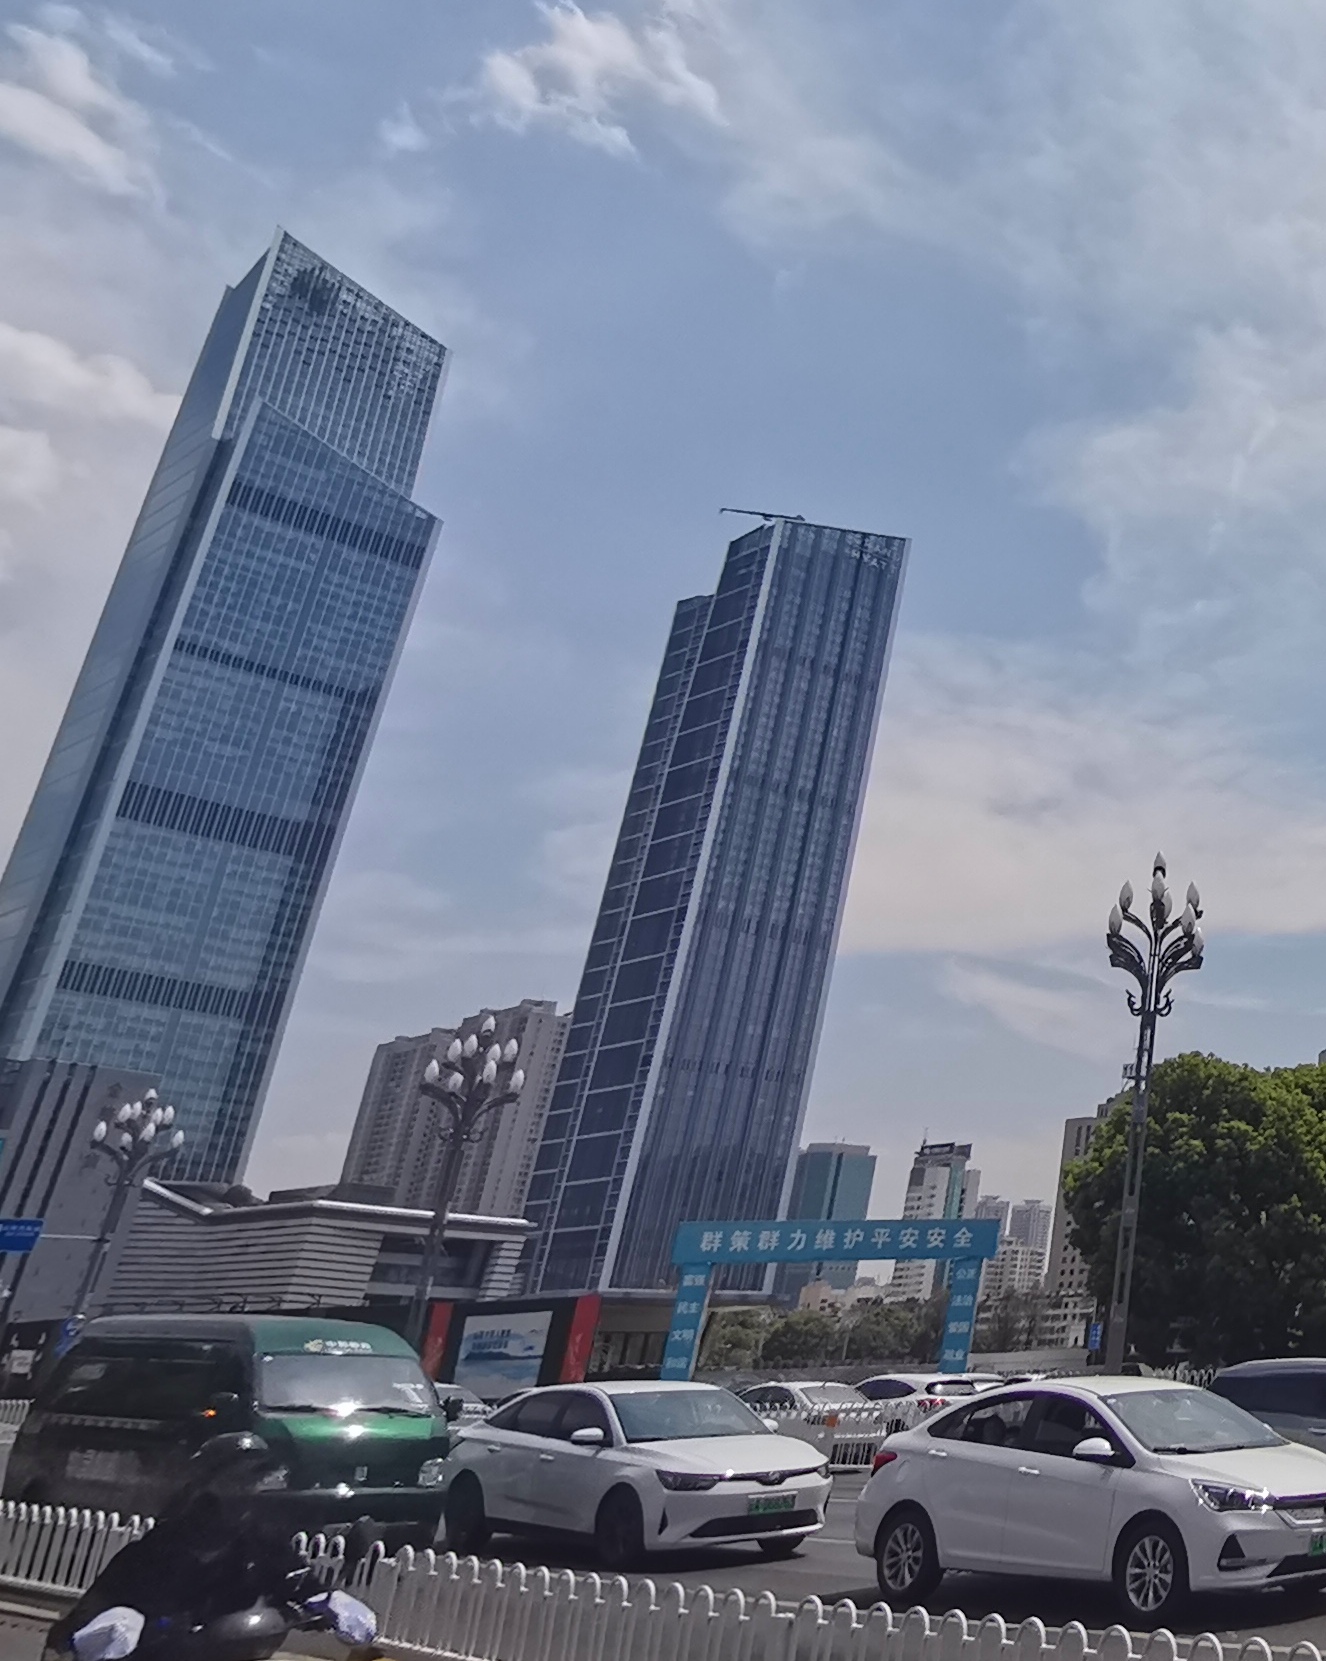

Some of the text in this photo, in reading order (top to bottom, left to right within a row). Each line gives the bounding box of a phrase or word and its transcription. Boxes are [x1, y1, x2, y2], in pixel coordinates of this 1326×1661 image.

[700, 1226, 974, 1252] 群策群力维护平安安全
